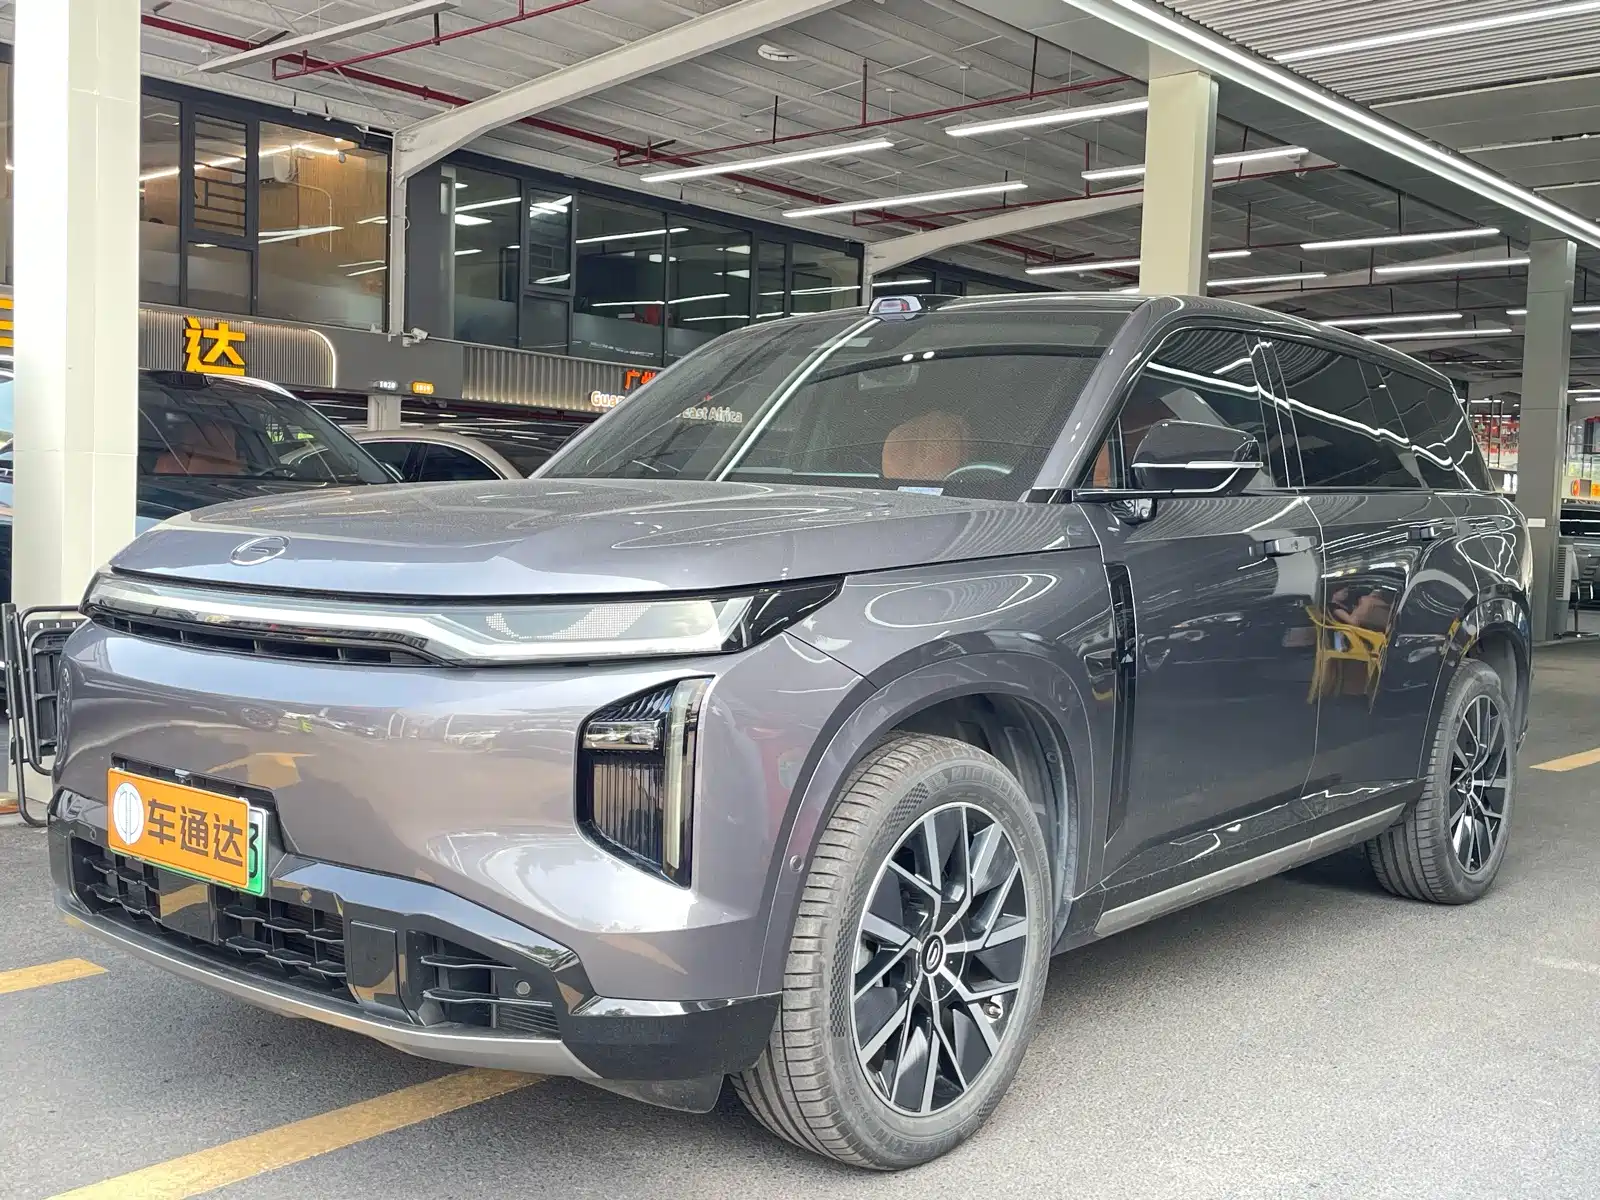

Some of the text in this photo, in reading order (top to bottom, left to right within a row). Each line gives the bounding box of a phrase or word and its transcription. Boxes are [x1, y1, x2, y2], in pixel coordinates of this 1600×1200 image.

[184, 316, 246, 376] 达
[708, 406, 743, 423] Africa
[147, 798, 244, 868] 车通达
